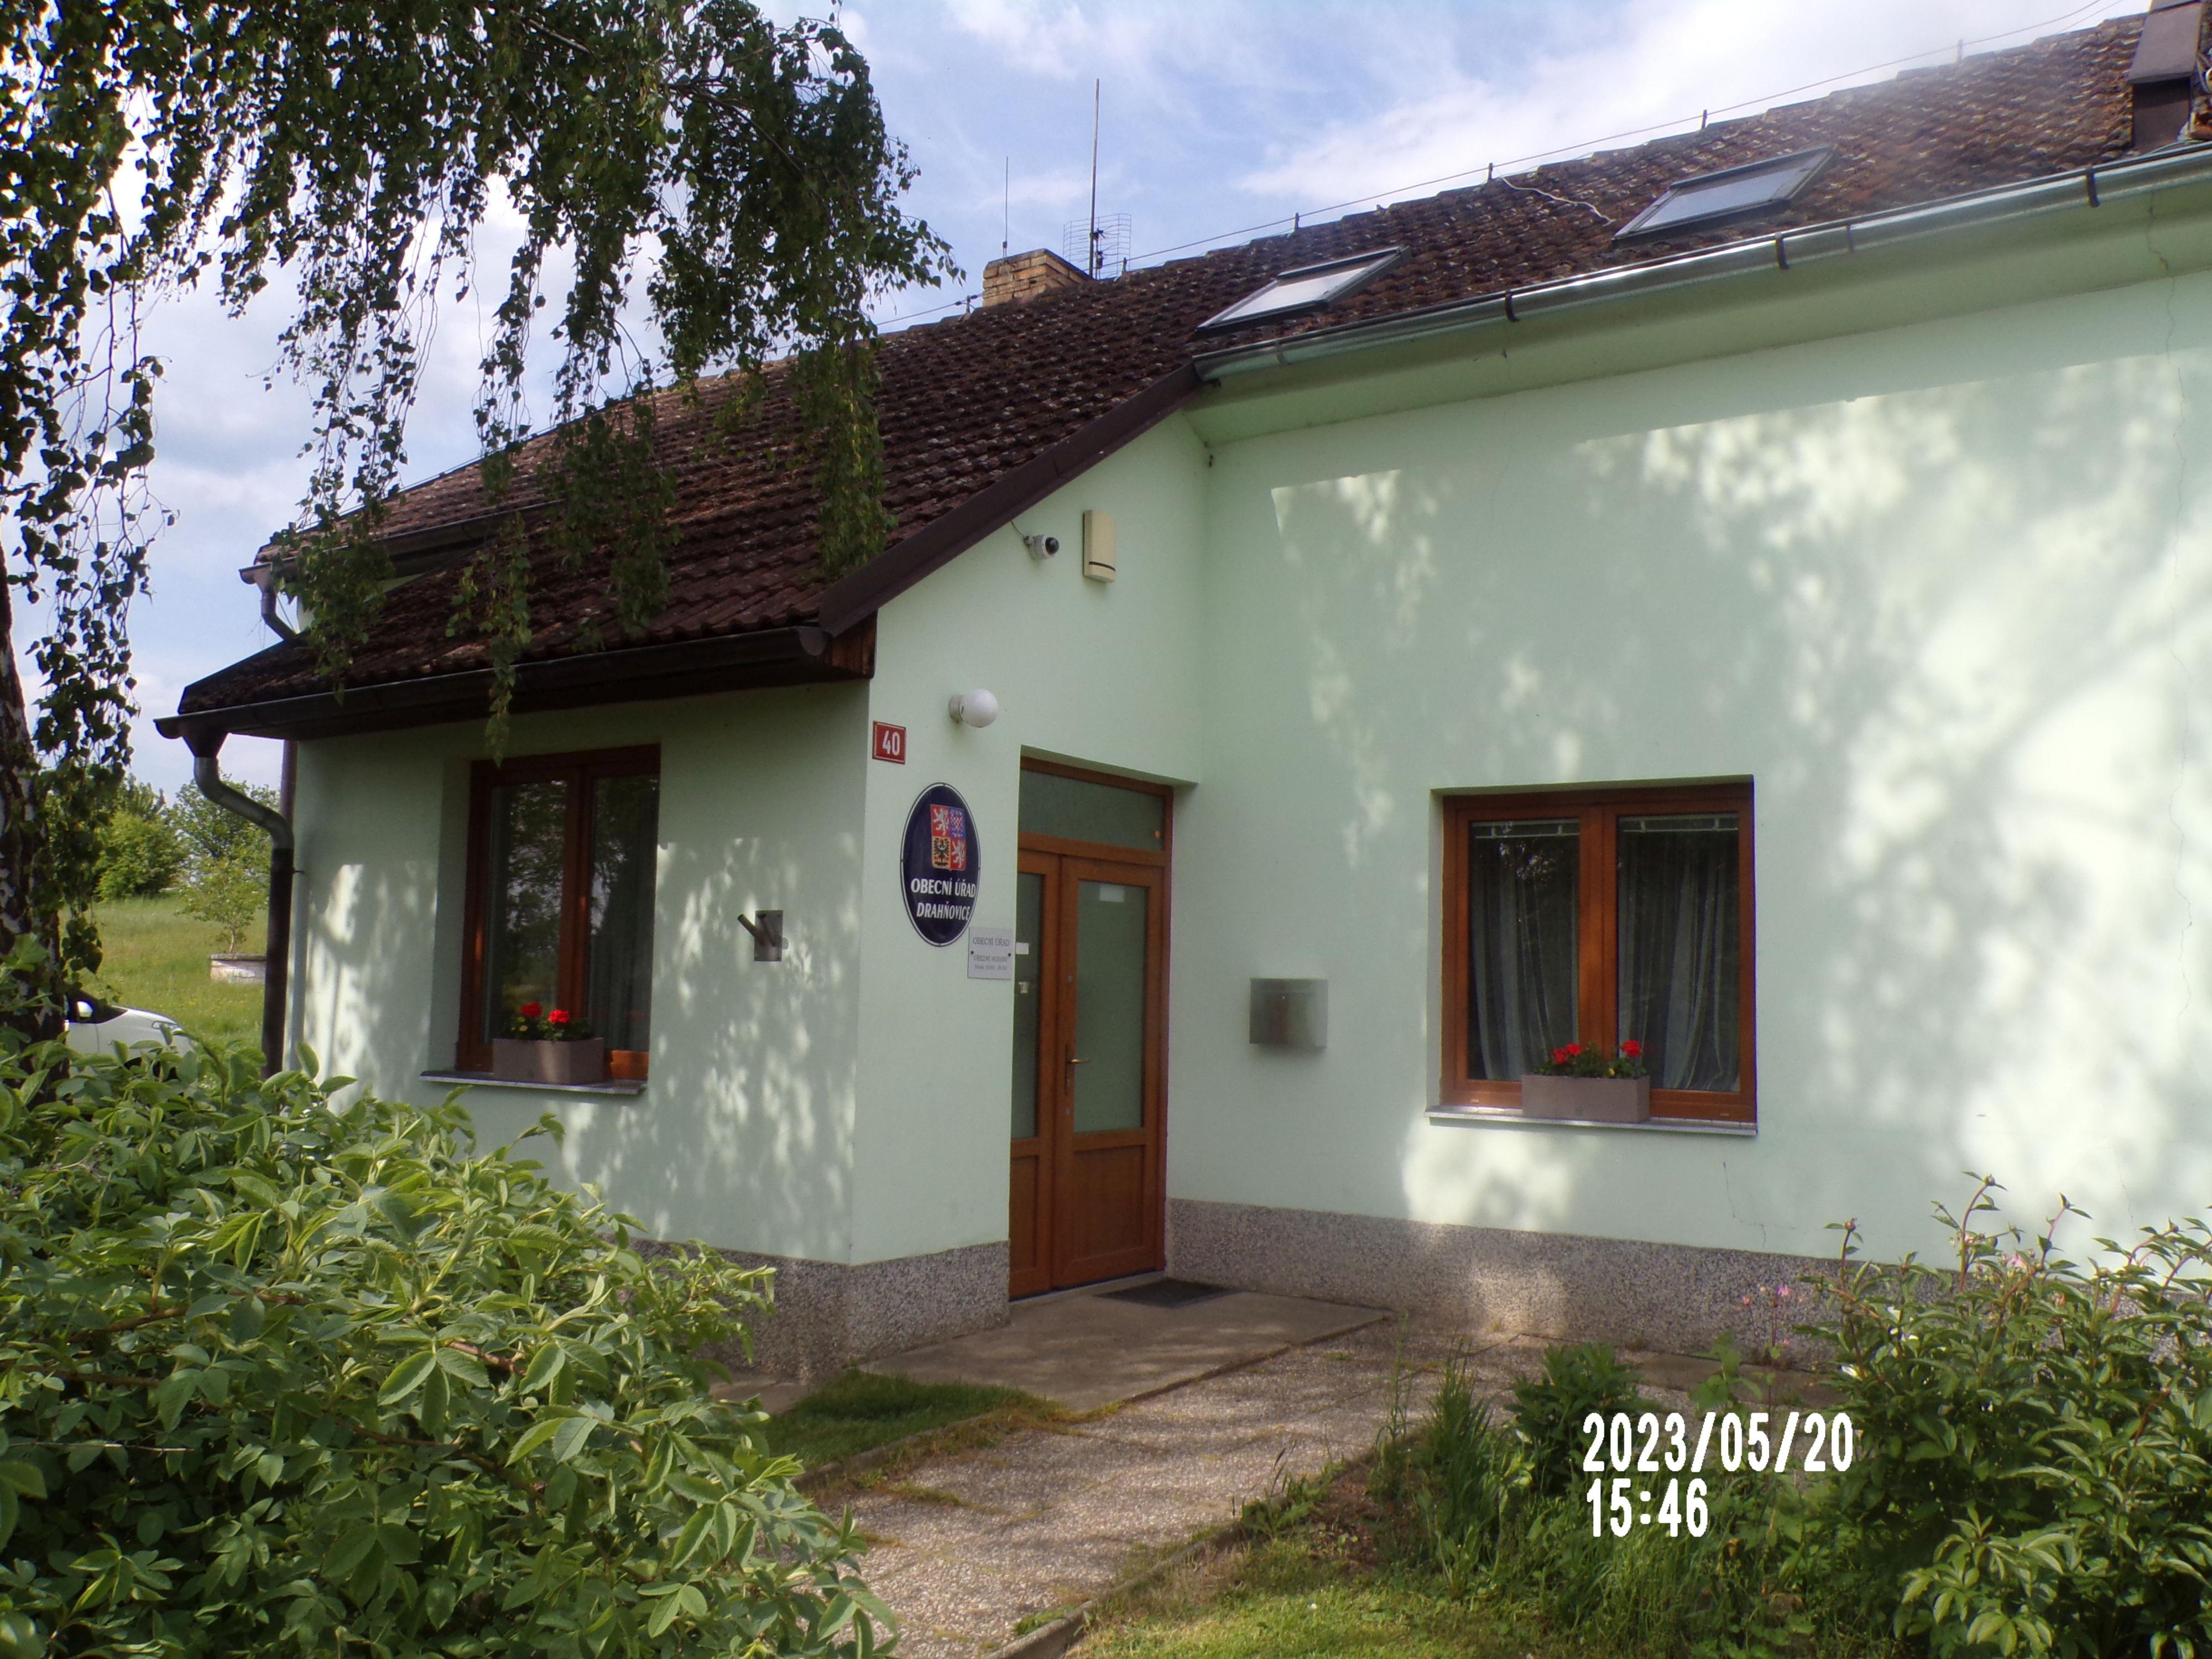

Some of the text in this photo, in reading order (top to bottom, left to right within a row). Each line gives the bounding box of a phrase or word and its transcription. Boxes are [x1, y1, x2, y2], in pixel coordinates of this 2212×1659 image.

[882, 731, 900, 755] 40
[911, 878, 977, 898] OBECNÍ ÚŘAD
[916, 901, 971, 920] DRAHŇOVICE
